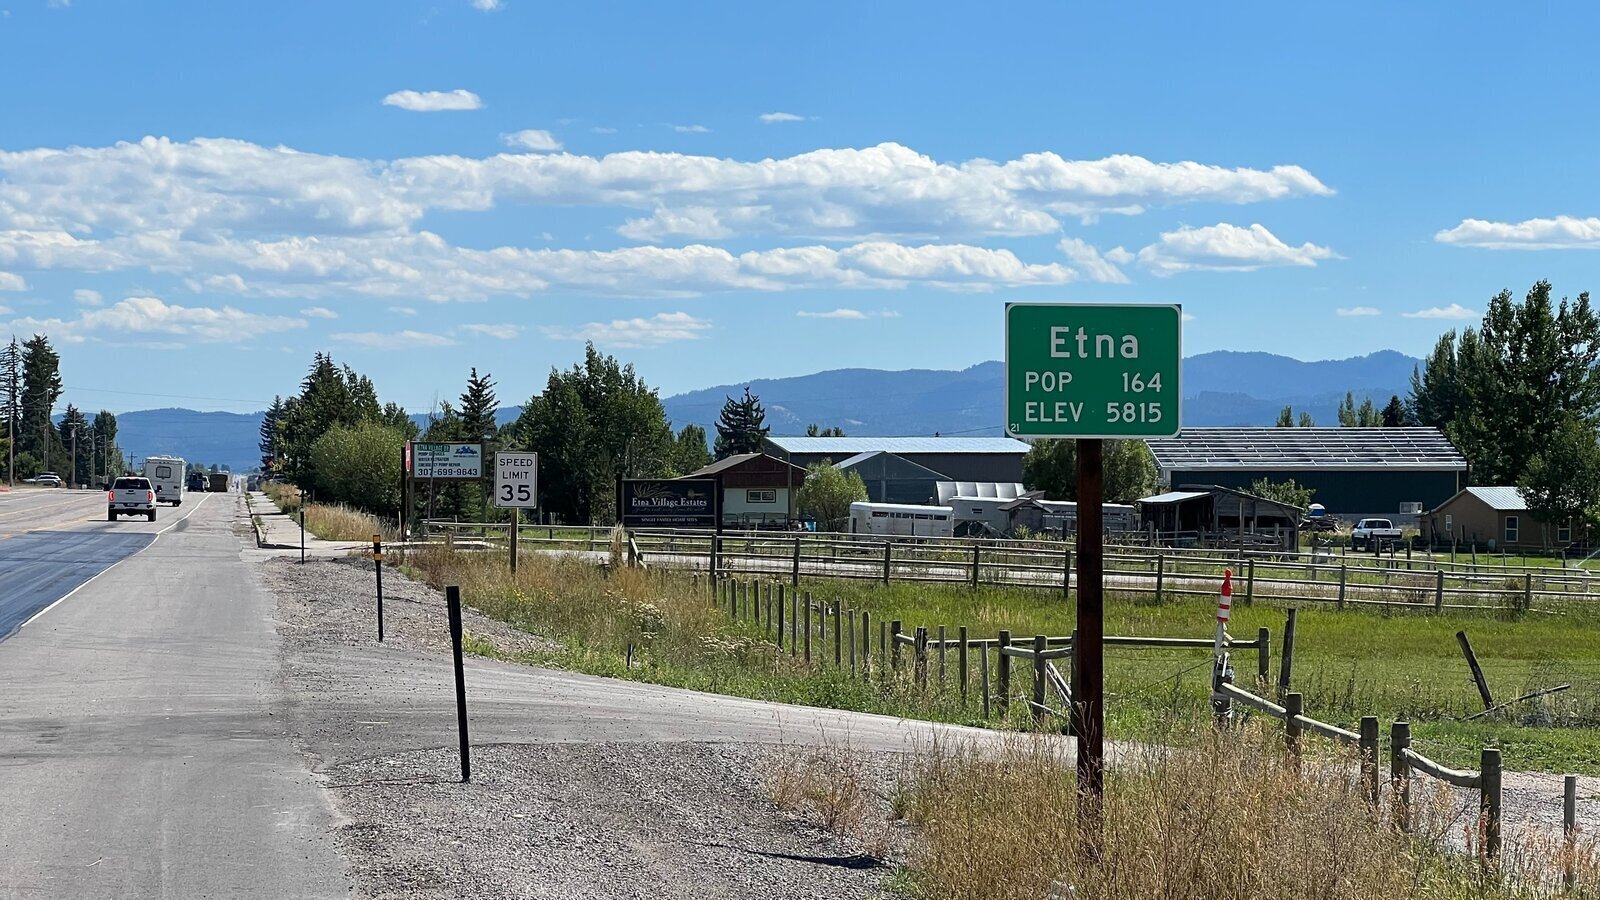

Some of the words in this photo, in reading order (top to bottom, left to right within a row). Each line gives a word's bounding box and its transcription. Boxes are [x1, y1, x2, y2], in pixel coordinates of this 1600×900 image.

[1050, 326, 1139, 359] Etna
[1025, 371, 1073, 392] POP
[1122, 372, 1162, 393] 164
[1025, 401, 1084, 422] ELEV
[1106, 402, 1162, 423] 5815
[1010, 423, 1020, 432] 21
[418, 468, 478, 476] 307-699-9643
[502, 471, 529, 479] LIMIT
[500, 484, 530, 502] 35
[632, 498, 649, 506] Etna
[652, 498, 678, 508] Village
[680, 498, 707, 506] Estates
